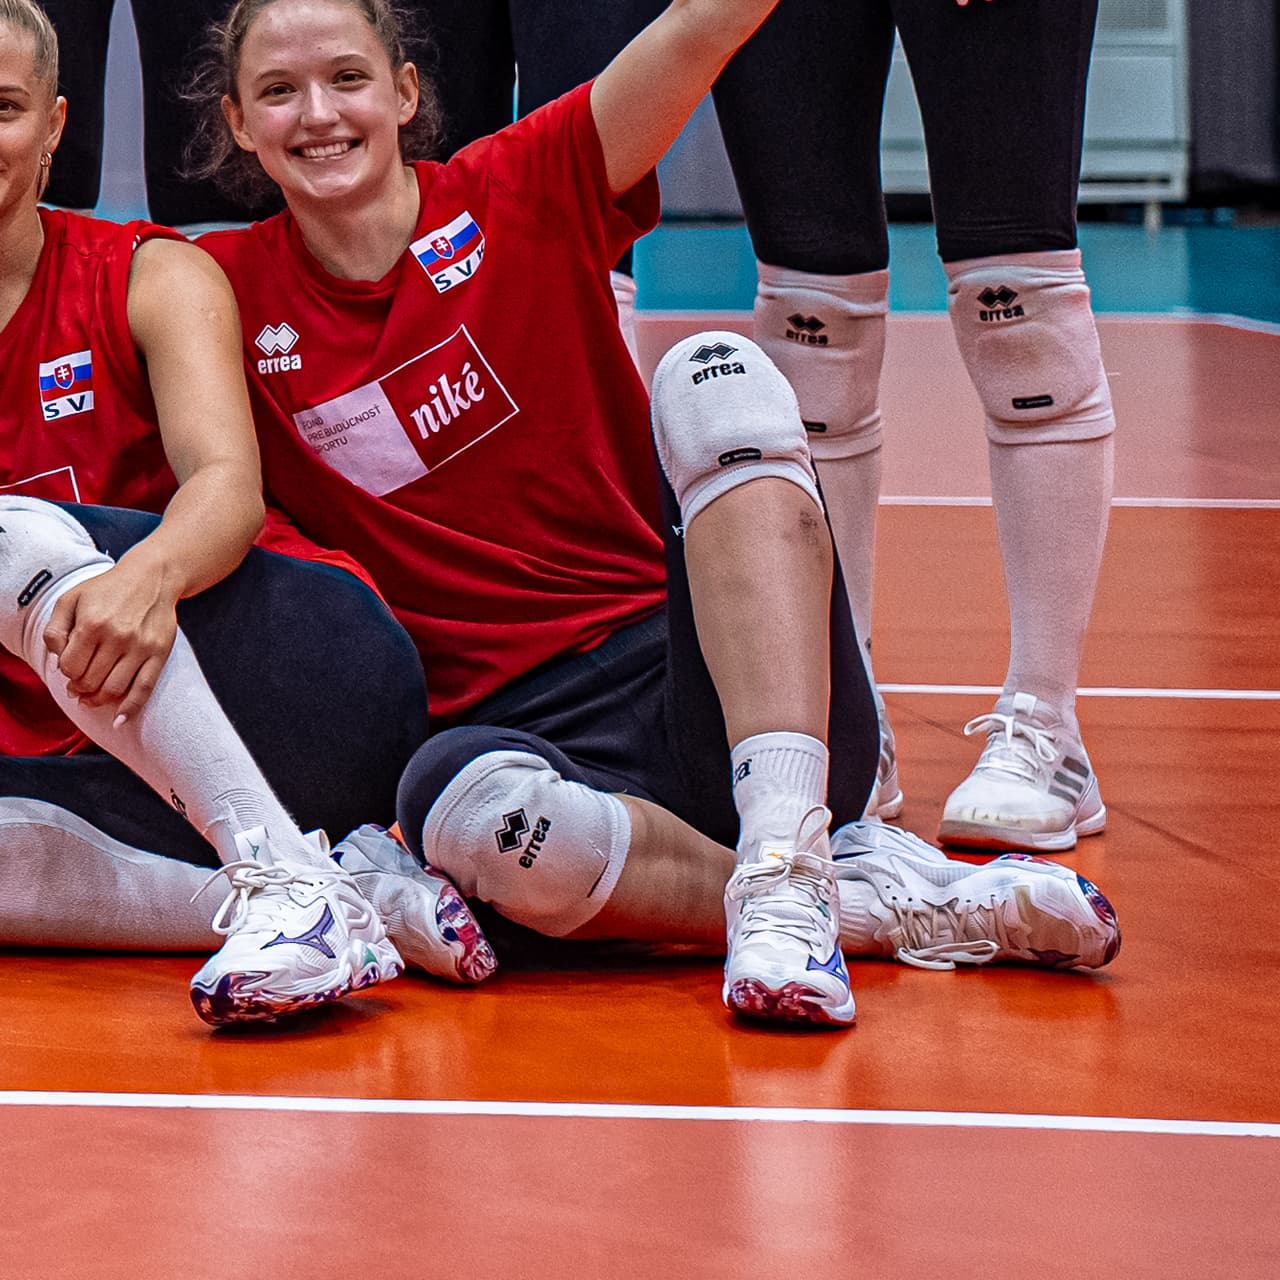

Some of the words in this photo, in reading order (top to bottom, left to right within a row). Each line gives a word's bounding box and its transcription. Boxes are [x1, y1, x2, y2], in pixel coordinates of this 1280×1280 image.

[257, 354, 302, 375] errea
[691, 361, 747, 386] errea
[409, 361, 486, 441] niké
[518, 816, 552, 870] errea
